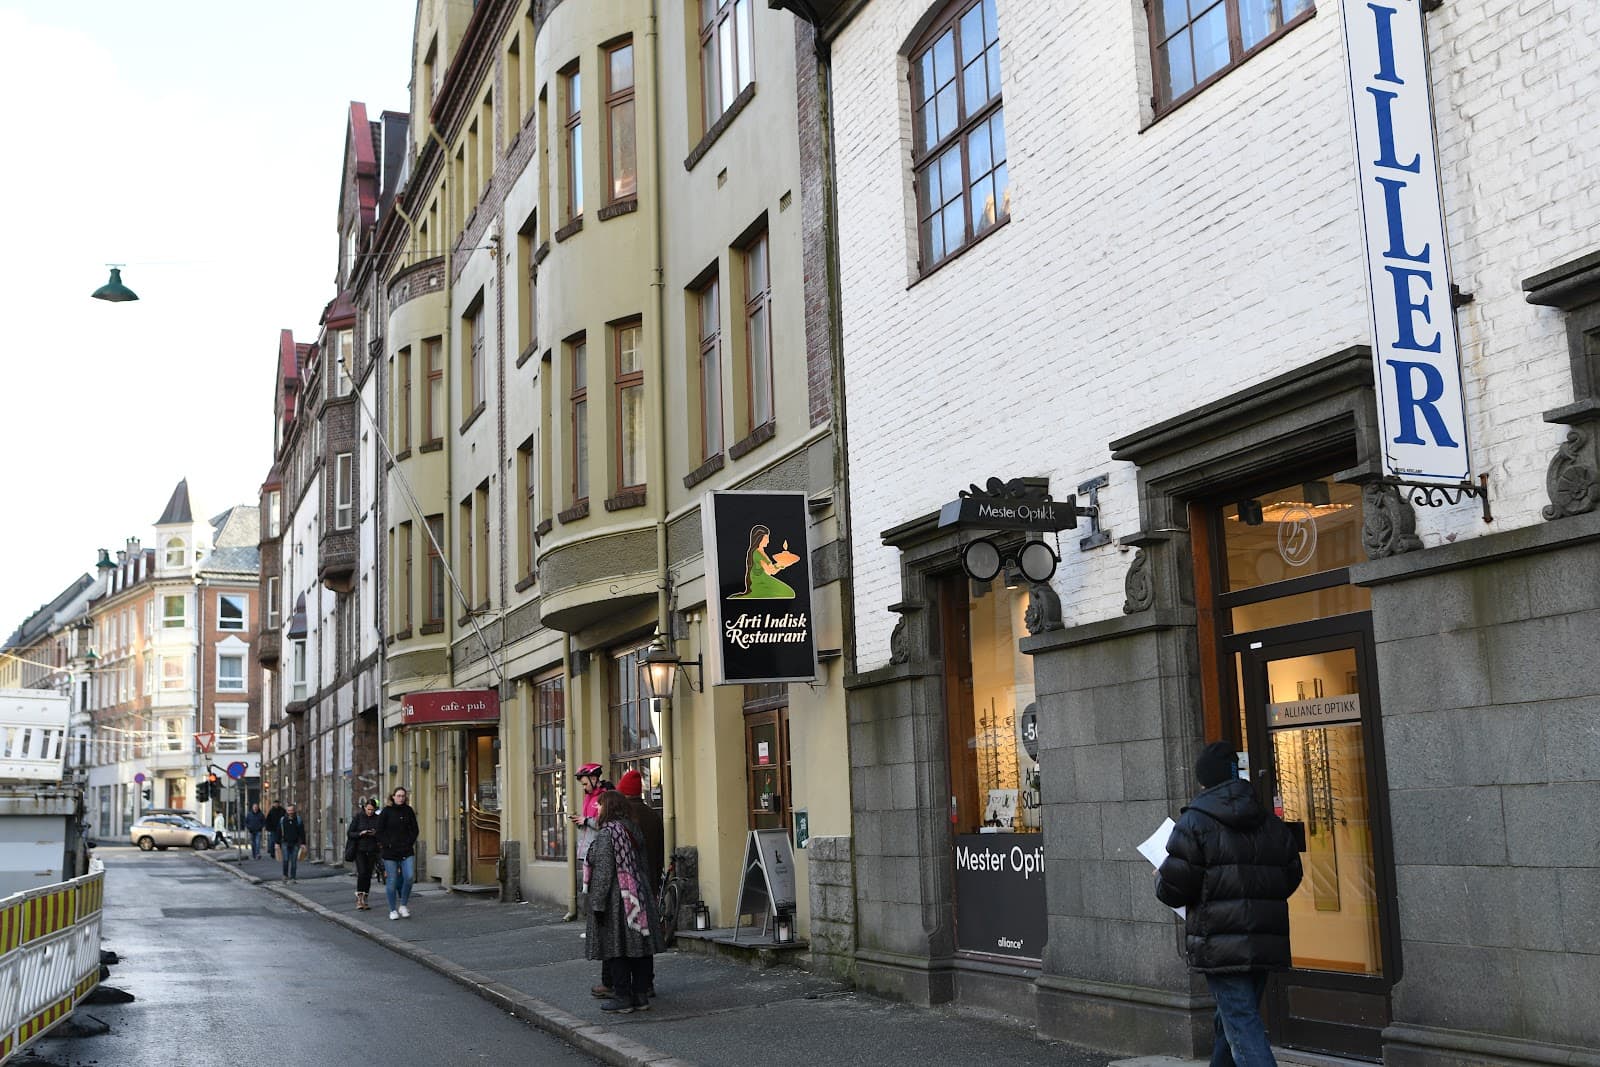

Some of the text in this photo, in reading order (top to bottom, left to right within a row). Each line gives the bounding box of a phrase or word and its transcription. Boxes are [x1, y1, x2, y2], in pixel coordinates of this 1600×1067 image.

[979, 503, 1056, 523] Mester Optikk
[1285, 518, 1309, 558] 25
[725, 612, 807, 630] Arti Indisk
[725, 629, 807, 650] Restaurant
[467, 700, 486, 713] pub
[1284, 699, 1356, 718] ALLIANCE OPTIKK
[956, 845, 1006, 872] Mester
